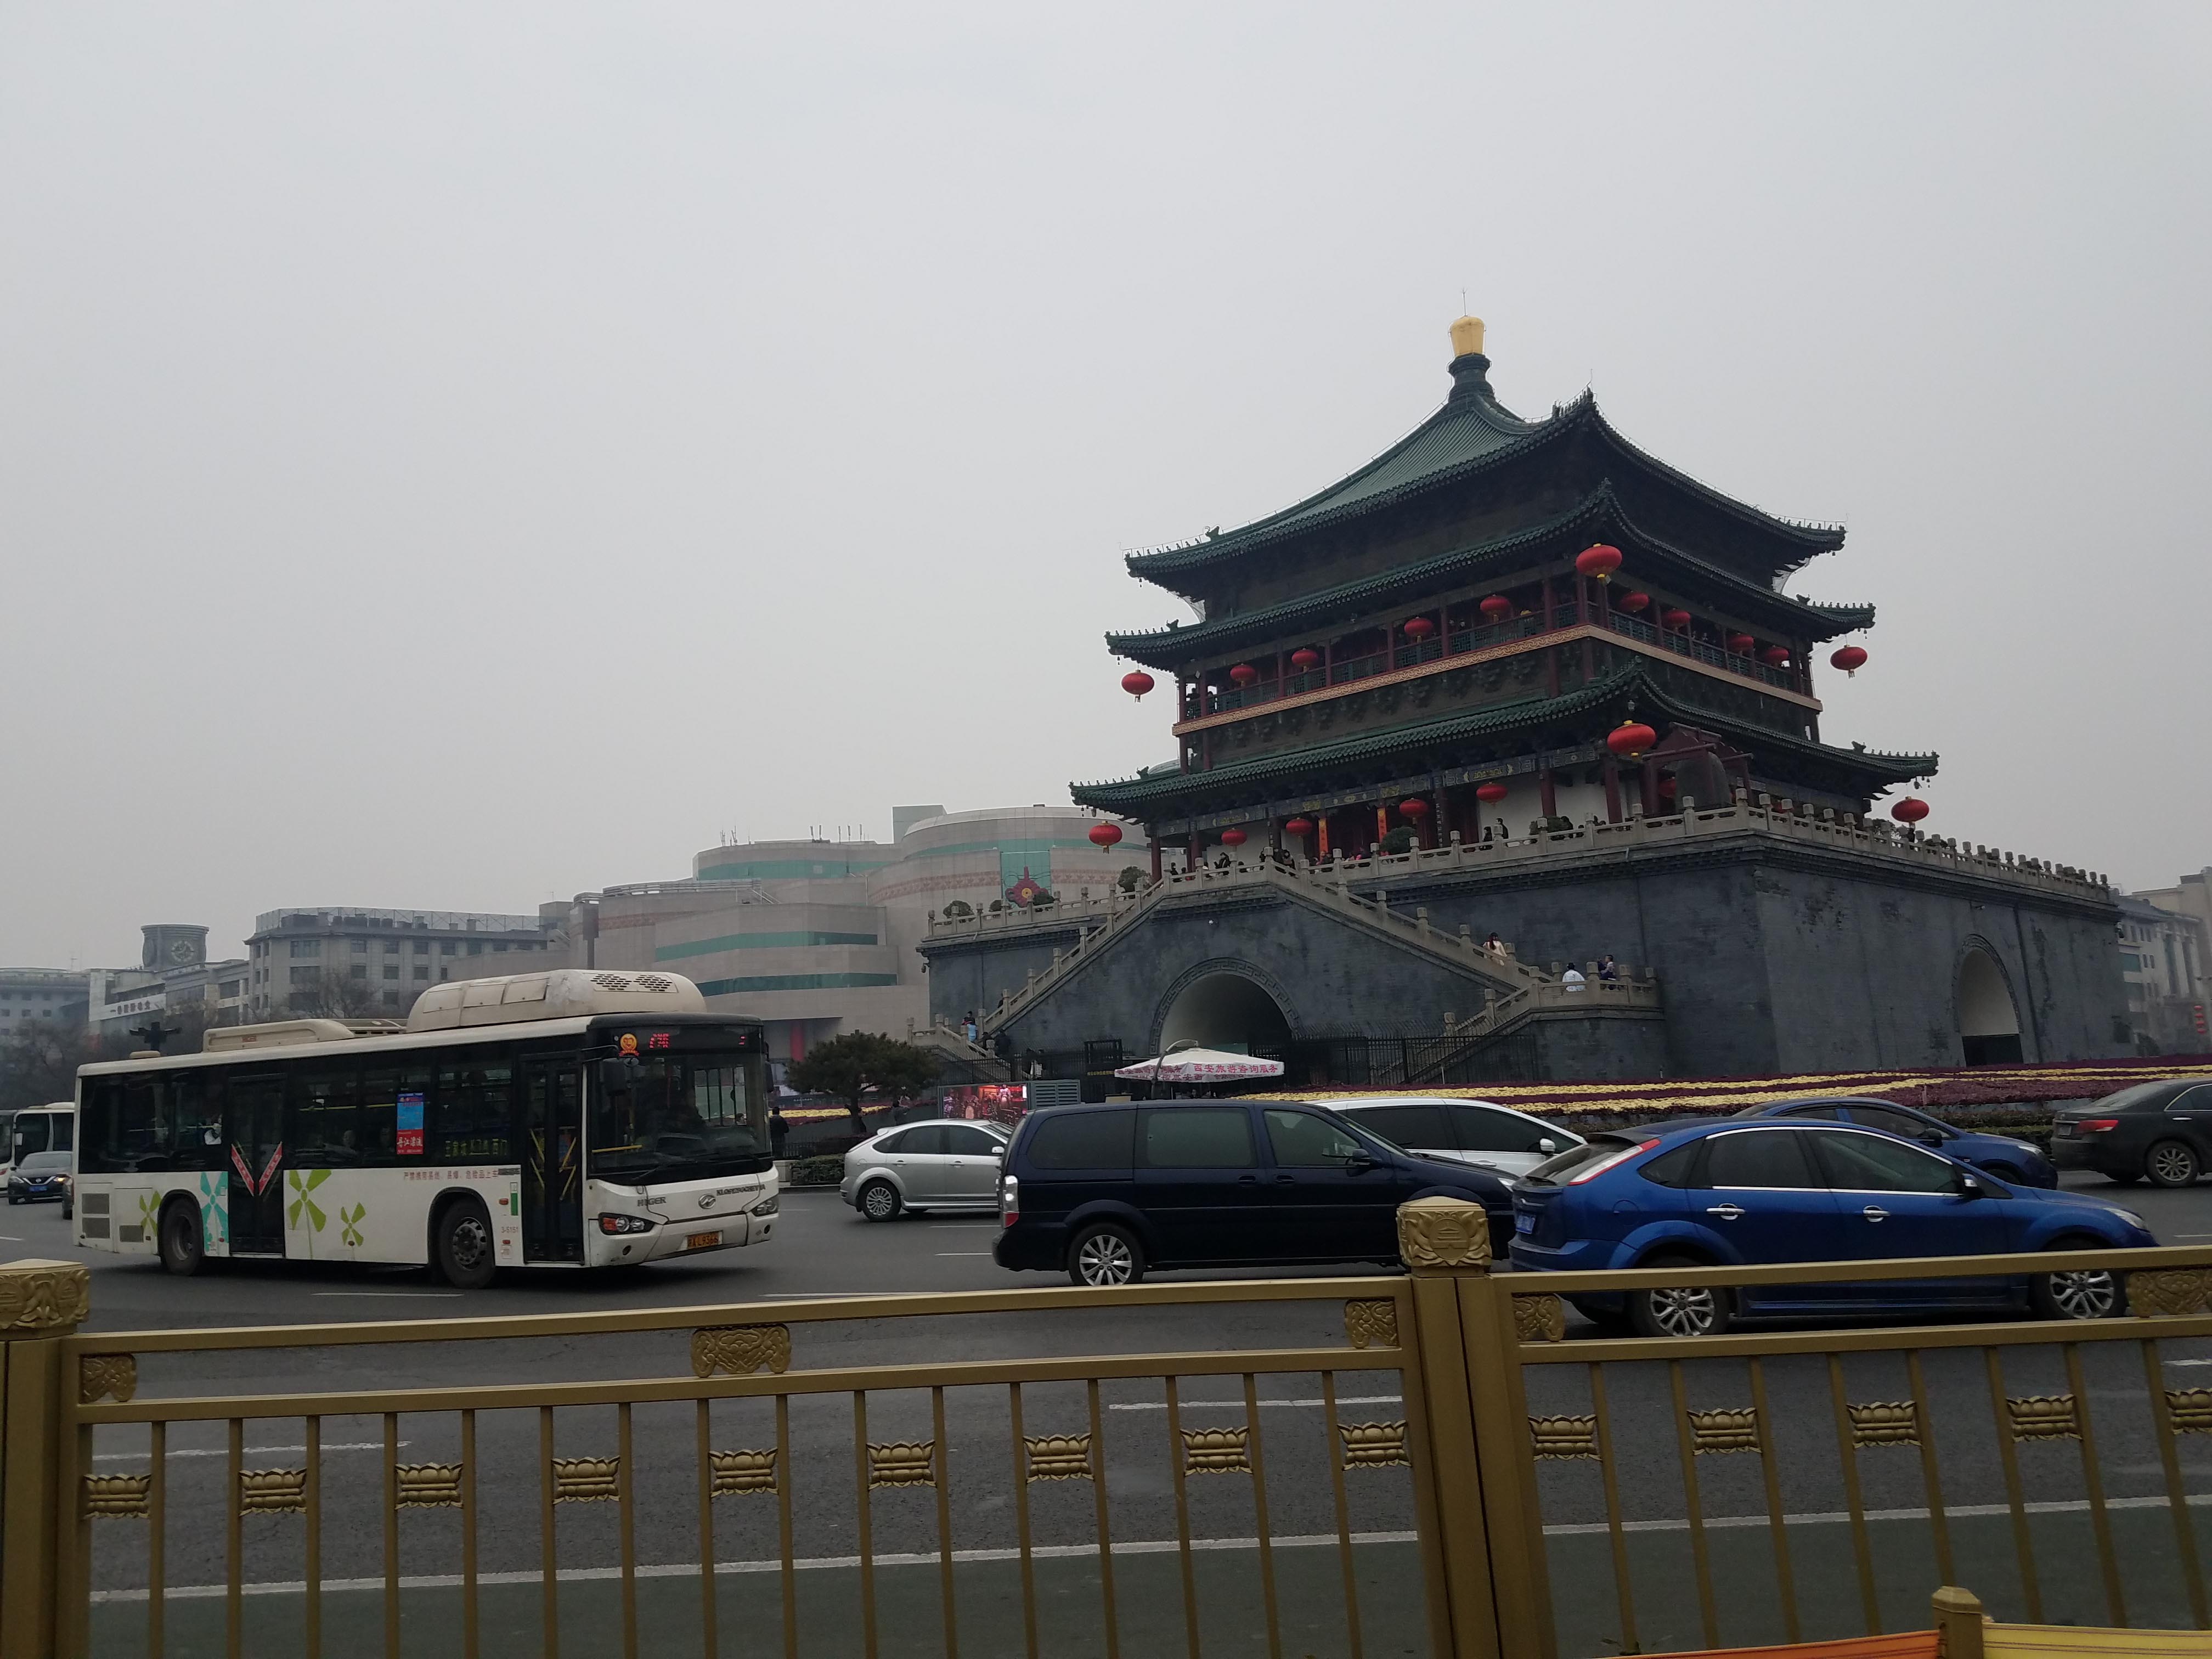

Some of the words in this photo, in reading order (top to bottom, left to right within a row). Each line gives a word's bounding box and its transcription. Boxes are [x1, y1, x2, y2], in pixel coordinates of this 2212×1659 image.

[1193, 1063, 1278, 1073] 西安旅游咨询服务
[637, 1197, 667, 1206] HIGER
